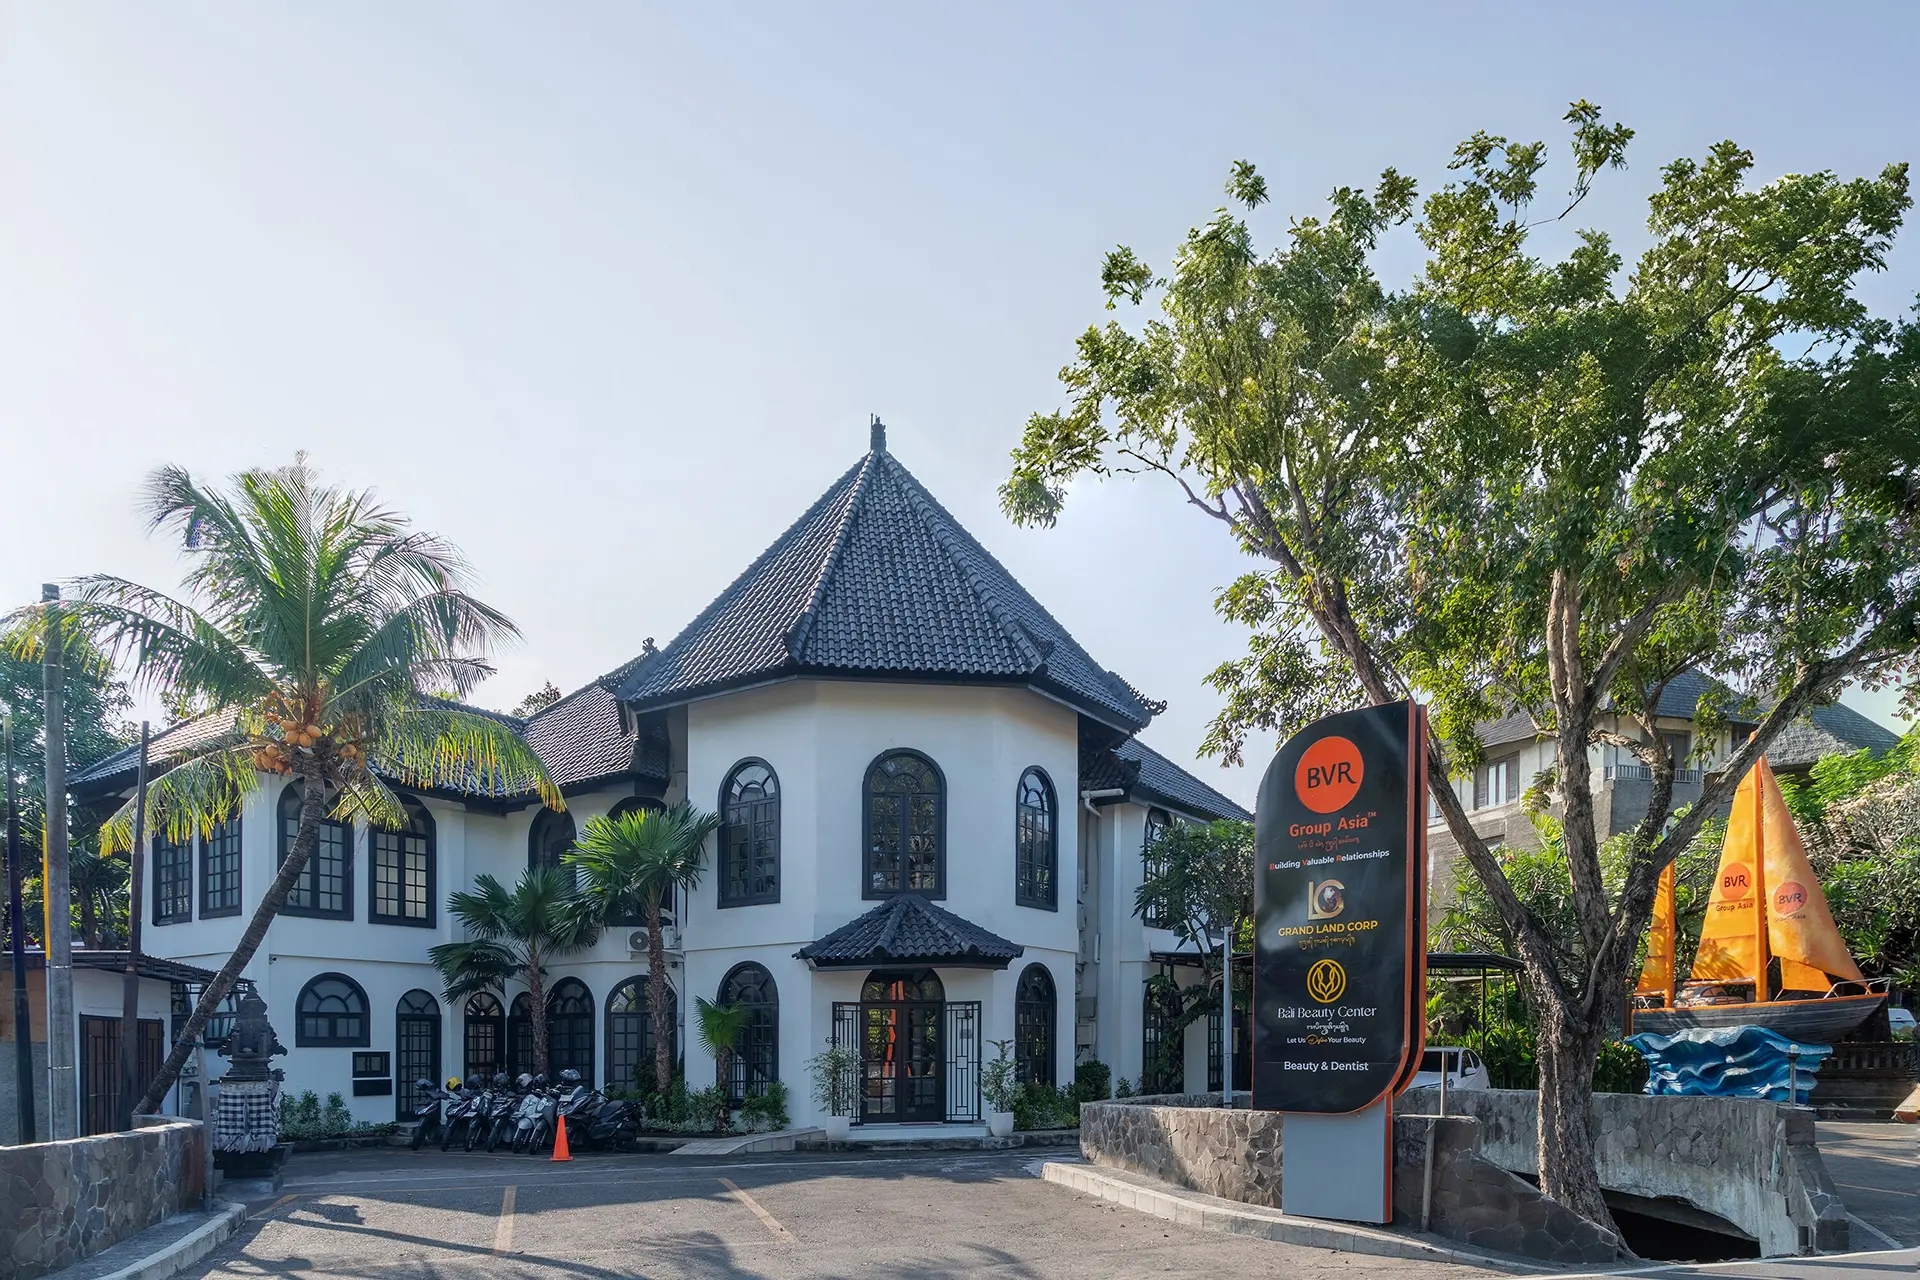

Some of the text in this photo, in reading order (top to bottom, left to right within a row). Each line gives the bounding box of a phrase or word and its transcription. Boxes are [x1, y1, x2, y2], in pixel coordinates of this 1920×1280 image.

[1307, 762, 1357, 789] BVR
[1289, 823, 1332, 837] Group
[1269, 849, 1390, 870] Building Valuable Relationships
[1724, 875, 1748, 888] BVR
[1778, 893, 1802, 905] BVR
[1716, 901, 1754, 912] Group Asia
[1278, 920, 1378, 936] GRAND LAND CORP
[1278, 1006, 1377, 1021] Bali Beauty Center
[1343, 1036, 1366, 1044] Beauty
[1284, 1061, 1369, 1072] Beauty & Dentist
